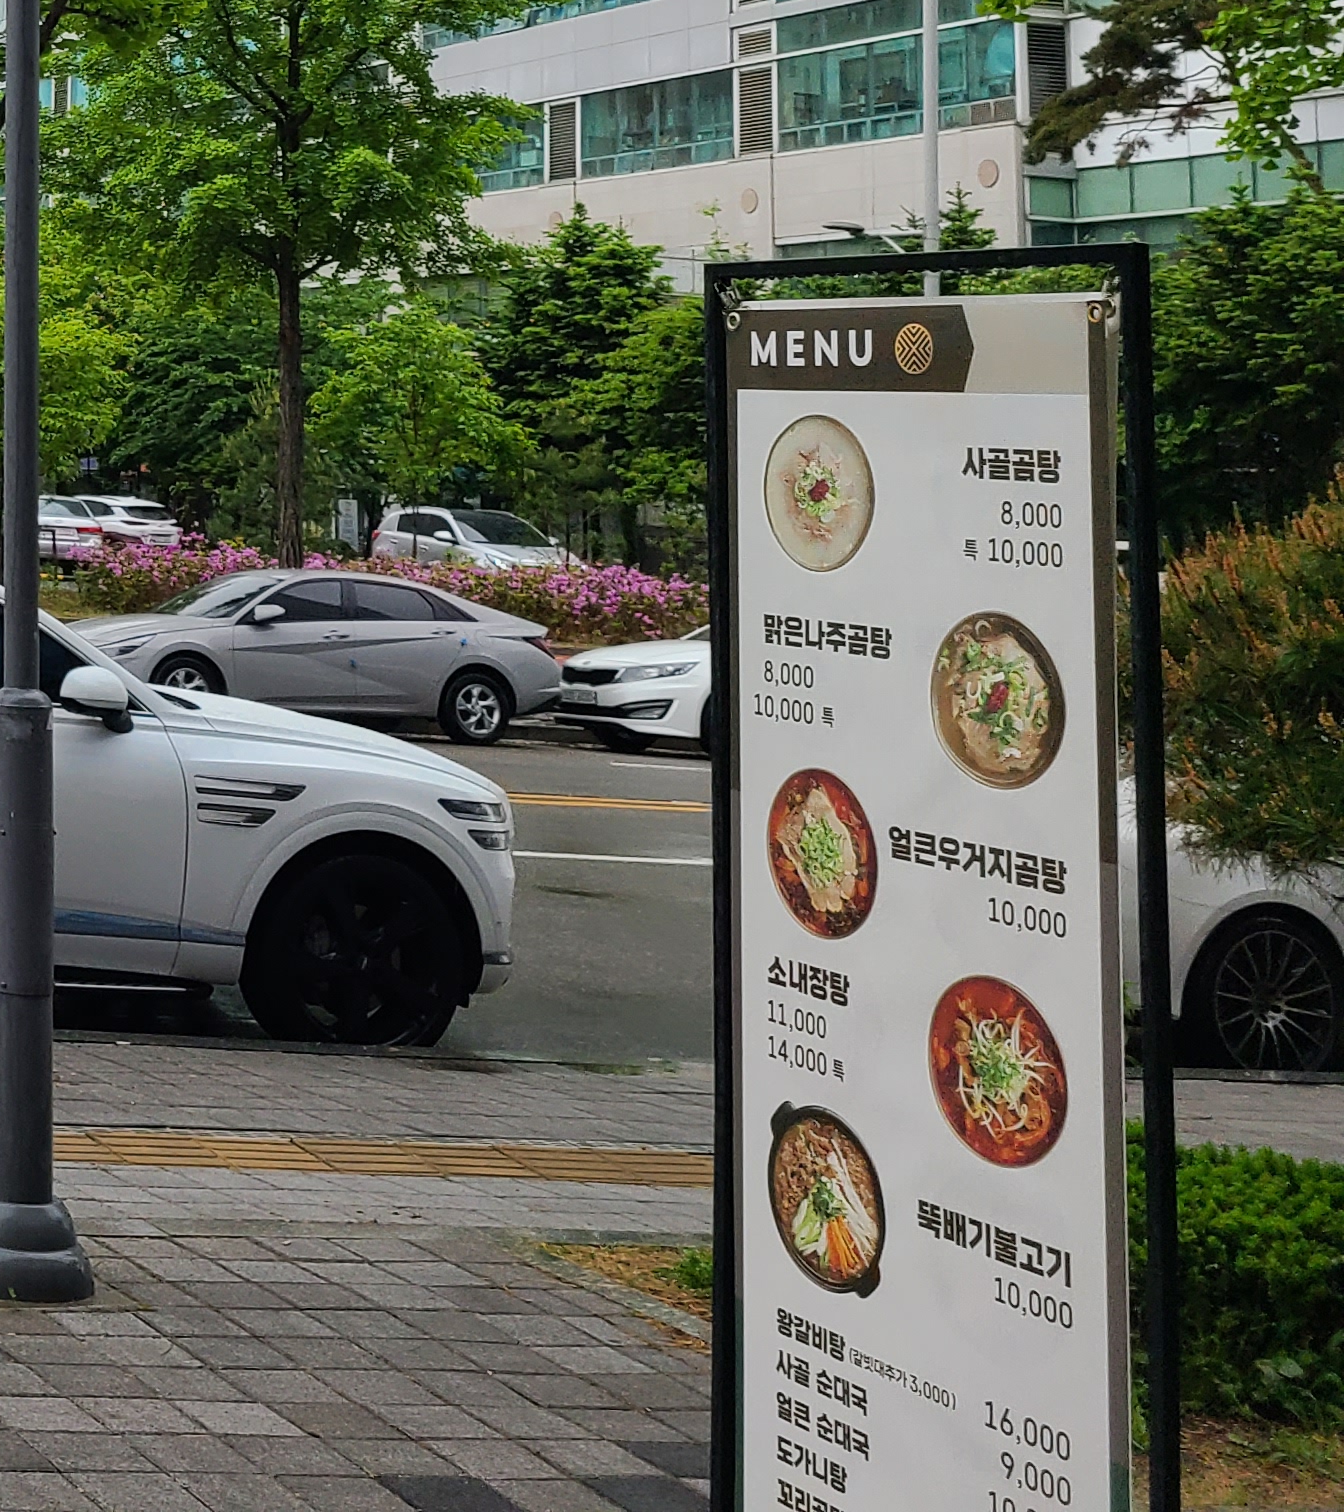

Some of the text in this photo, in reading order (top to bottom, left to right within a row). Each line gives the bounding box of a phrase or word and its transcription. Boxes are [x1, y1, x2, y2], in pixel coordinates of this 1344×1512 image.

[749, 329, 874, 368] MENU
[961, 446, 1062, 485] 사골곰탕
[1000, 499, 1064, 530] 8,000
[962, 536, 1064, 570] 특 10,000
[763, 612, 893, 661] 맑은나주곰탕
[763, 659, 815, 691] 8,000
[753, 692, 836, 729] 10,000 특
[888, 824, 1068, 896] 얼큰우거지곰탕
[987, 895, 1068, 939] 10,000
[767, 955, 851, 1008] 소내장탕
[767, 999, 828, 1041] 11,000
[767, 1034, 846, 1083] 14,000 특
[916, 1197, 1073, 1289] 뚝배기불고기
[993, 1276, 1074, 1330] 10,000
[776, 1306, 847, 1363] 왕갈비탕
[984, 1399, 1072, 1462] 16,000
[776, 1390, 870, 1462] 얼큰 순대국
[776, 1348, 812, 1384] 사골
[816, 1368, 869, 1418] 순대국
[999, 1450, 1072, 1507] 9,000
[776, 1434, 848, 1495] 도가니탕
